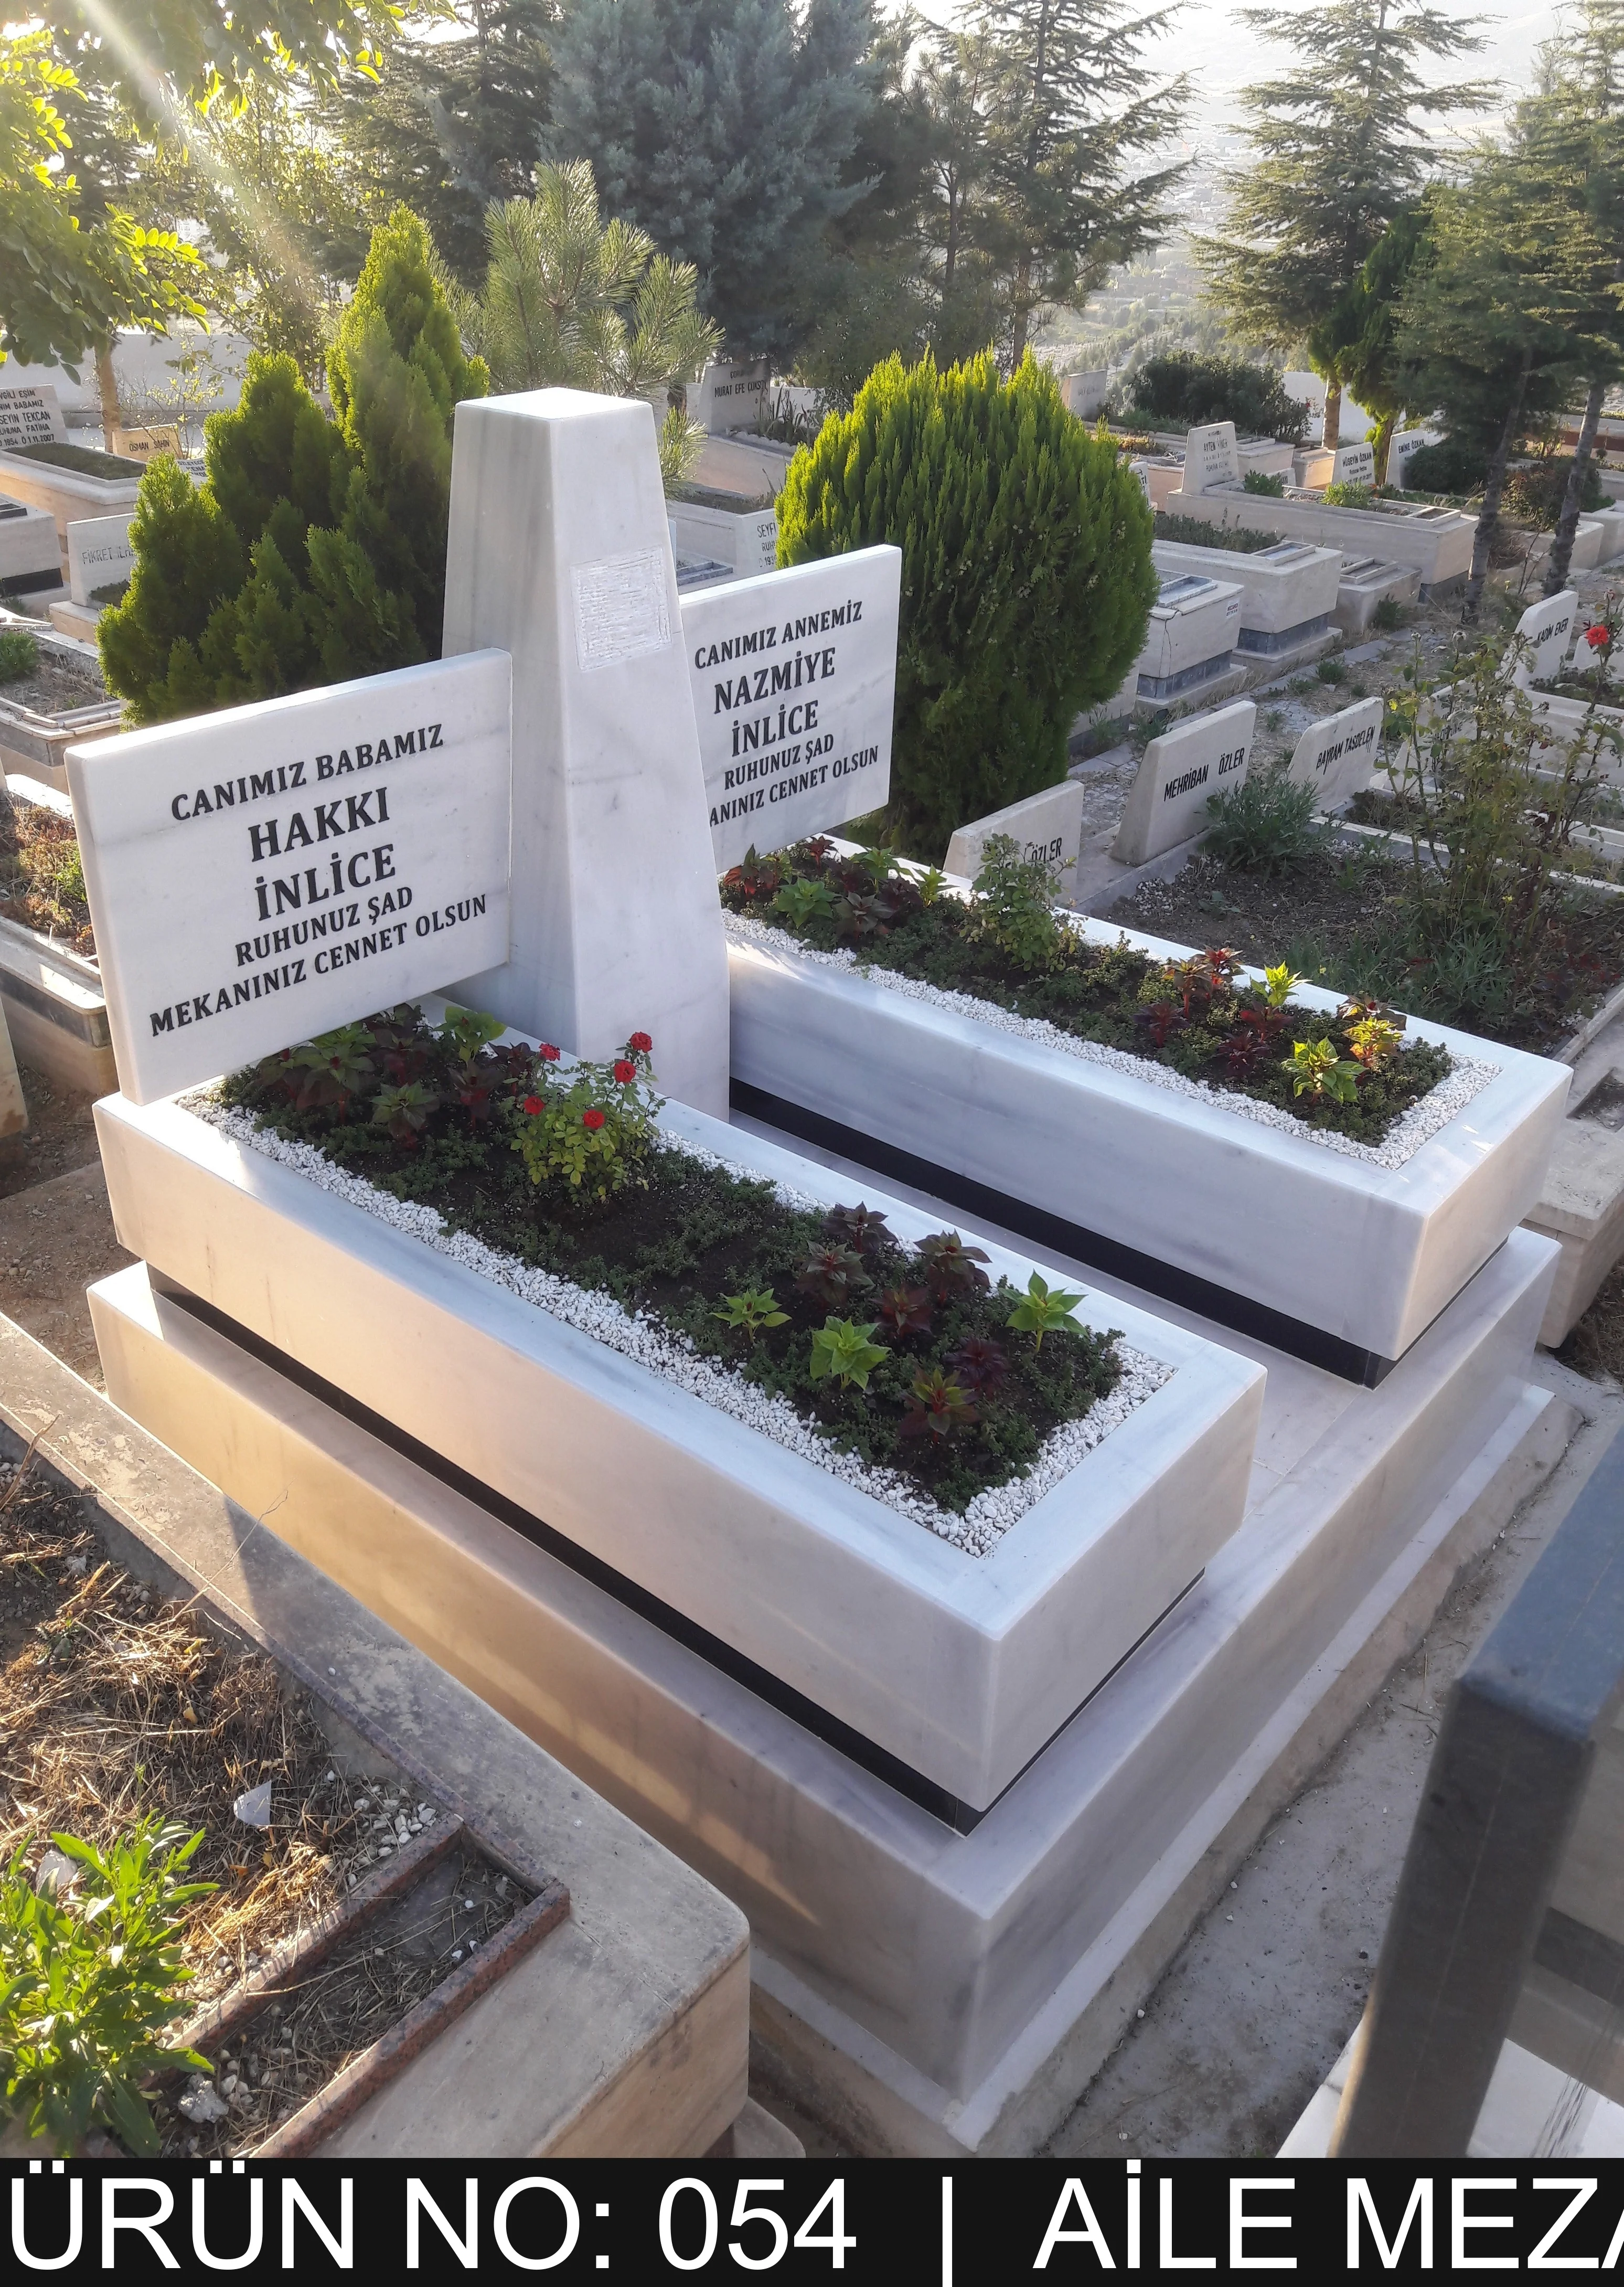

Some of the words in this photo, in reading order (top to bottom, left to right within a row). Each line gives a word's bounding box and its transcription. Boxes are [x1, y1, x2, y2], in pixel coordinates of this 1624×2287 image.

[13, 400, 44, 409] BABAMIZ
[22, 411, 51, 422] TEKCAN
[714, 385, 732, 397] MURAT
[735, 383, 745, 394] EFE
[130, 442, 149, 452] OSMAN
[1343, 454, 1359, 467] HÜSEYİN
[1360, 452, 1372, 462] ÖZKAN
[1412, 439, 1425, 449] ÖZKAN
[82, 547, 112, 565] FİKRET
[695, 627, 776, 669] CANIMIZ
[782, 600, 862, 644] ANNEMİZ
[714, 647, 836, 714] NAZMİYE
[732, 699, 818, 757] İNLİCE
[1316, 740, 1344, 772] BAYRAM
[172, 761, 307, 821] CANIMIZ
[315, 724, 443, 781] BABAMIZ
[724, 744, 801, 791] RUHUNUZ
[805, 734, 834, 765] ŞAD
[770, 764, 828, 803] CENNET
[832, 745, 879, 779] OLSUN
[1163, 764, 1209, 802] MEHRİBAN
[1218, 747, 1245, 775] ÖZLER
[248, 786, 390, 863] HAKKI
[1031, 837, 1062, 864] ÖZLER
[254, 843, 396, 921] İNLİCE
[235, 903, 360, 967] RUHUNUZ
[368, 887, 413, 926] ŞAD
[149, 959, 307, 1037] MEKANINIZ
[314, 922, 408, 974] CENNET
[415, 893, 487, 937] OLSUN
